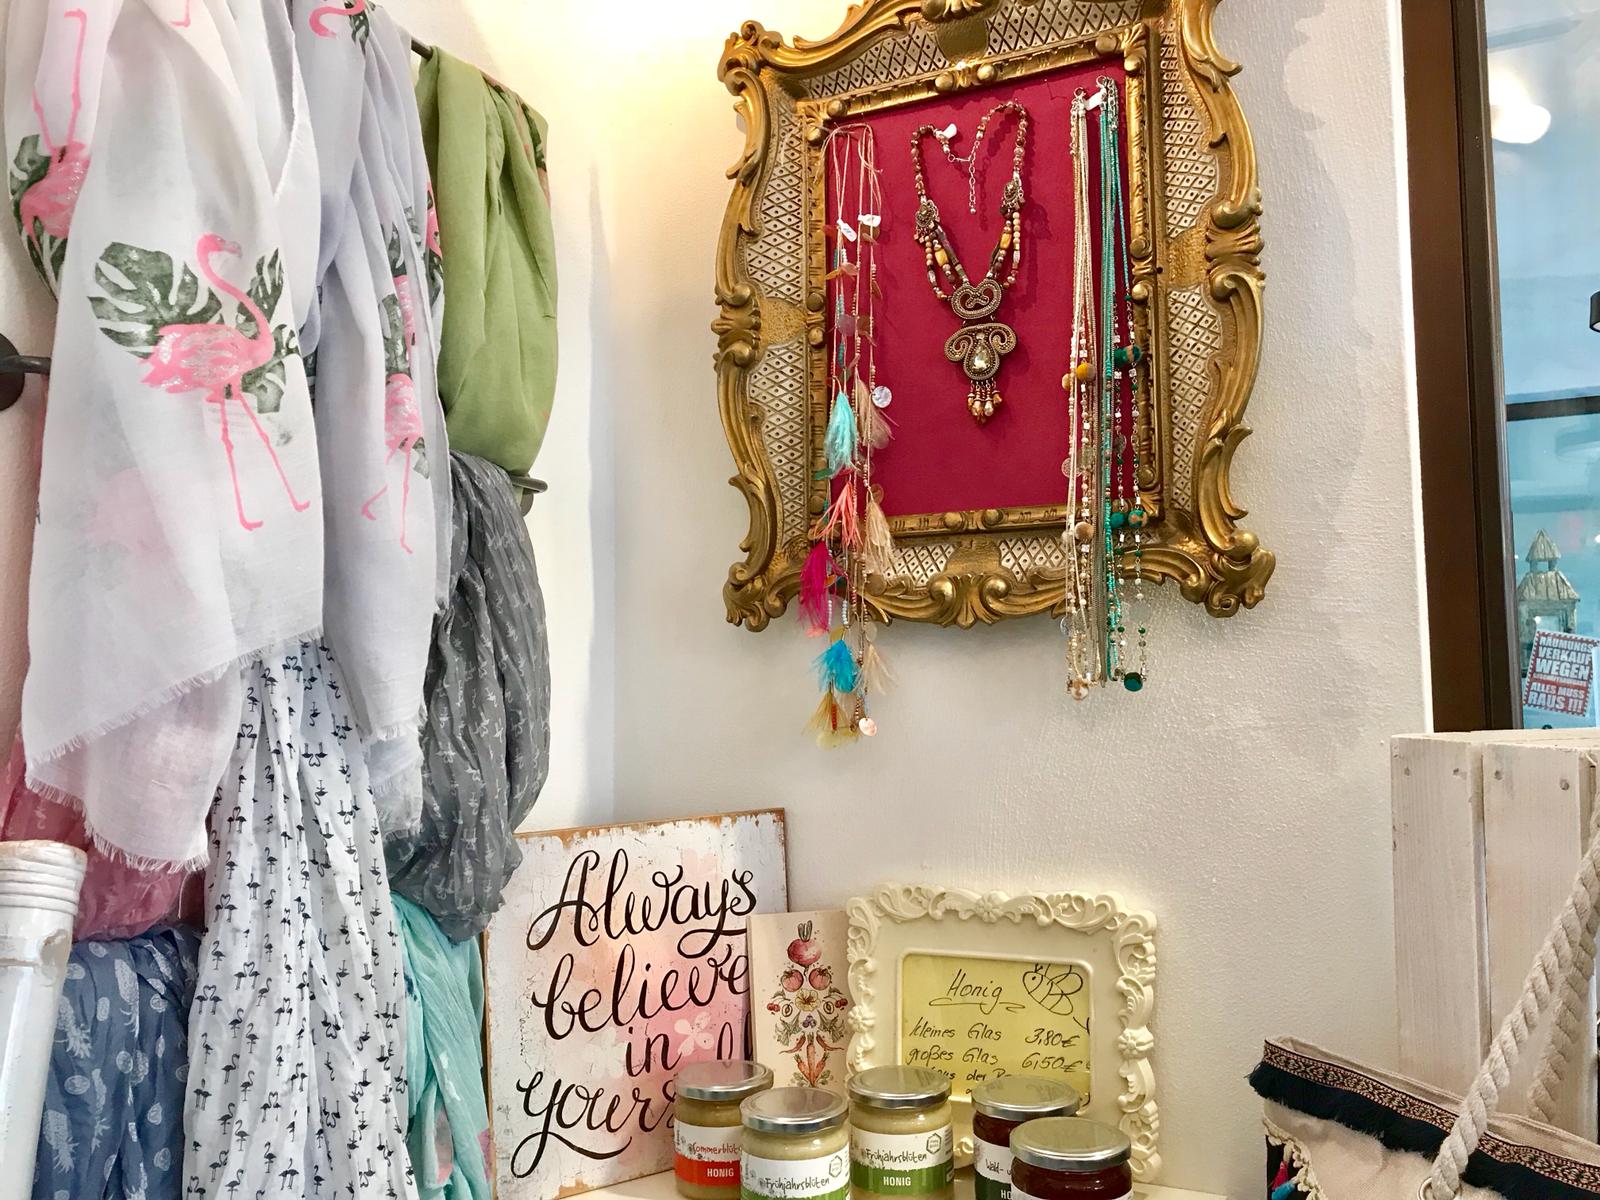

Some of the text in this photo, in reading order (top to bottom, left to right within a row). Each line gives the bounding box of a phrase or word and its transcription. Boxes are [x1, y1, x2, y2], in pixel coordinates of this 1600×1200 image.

[1535, 658, 1589, 680] WEGEN
[1530, 682, 1556, 694] ALLES
[1528, 691, 1566, 710] RAUS
[526, 848, 757, 959] Always
[531, 943, 749, 1041] believe
[946, 968, 1004, 1015] Honig
[909, 1016, 956, 1039] kleines
[967, 1022, 1002, 1041] Glas
[625, 1026, 681, 1077] in
[962, 1047, 998, 1066] Glas
[707, 1168, 735, 1178] HONIG
[883, 1176, 912, 1187] HONIG
